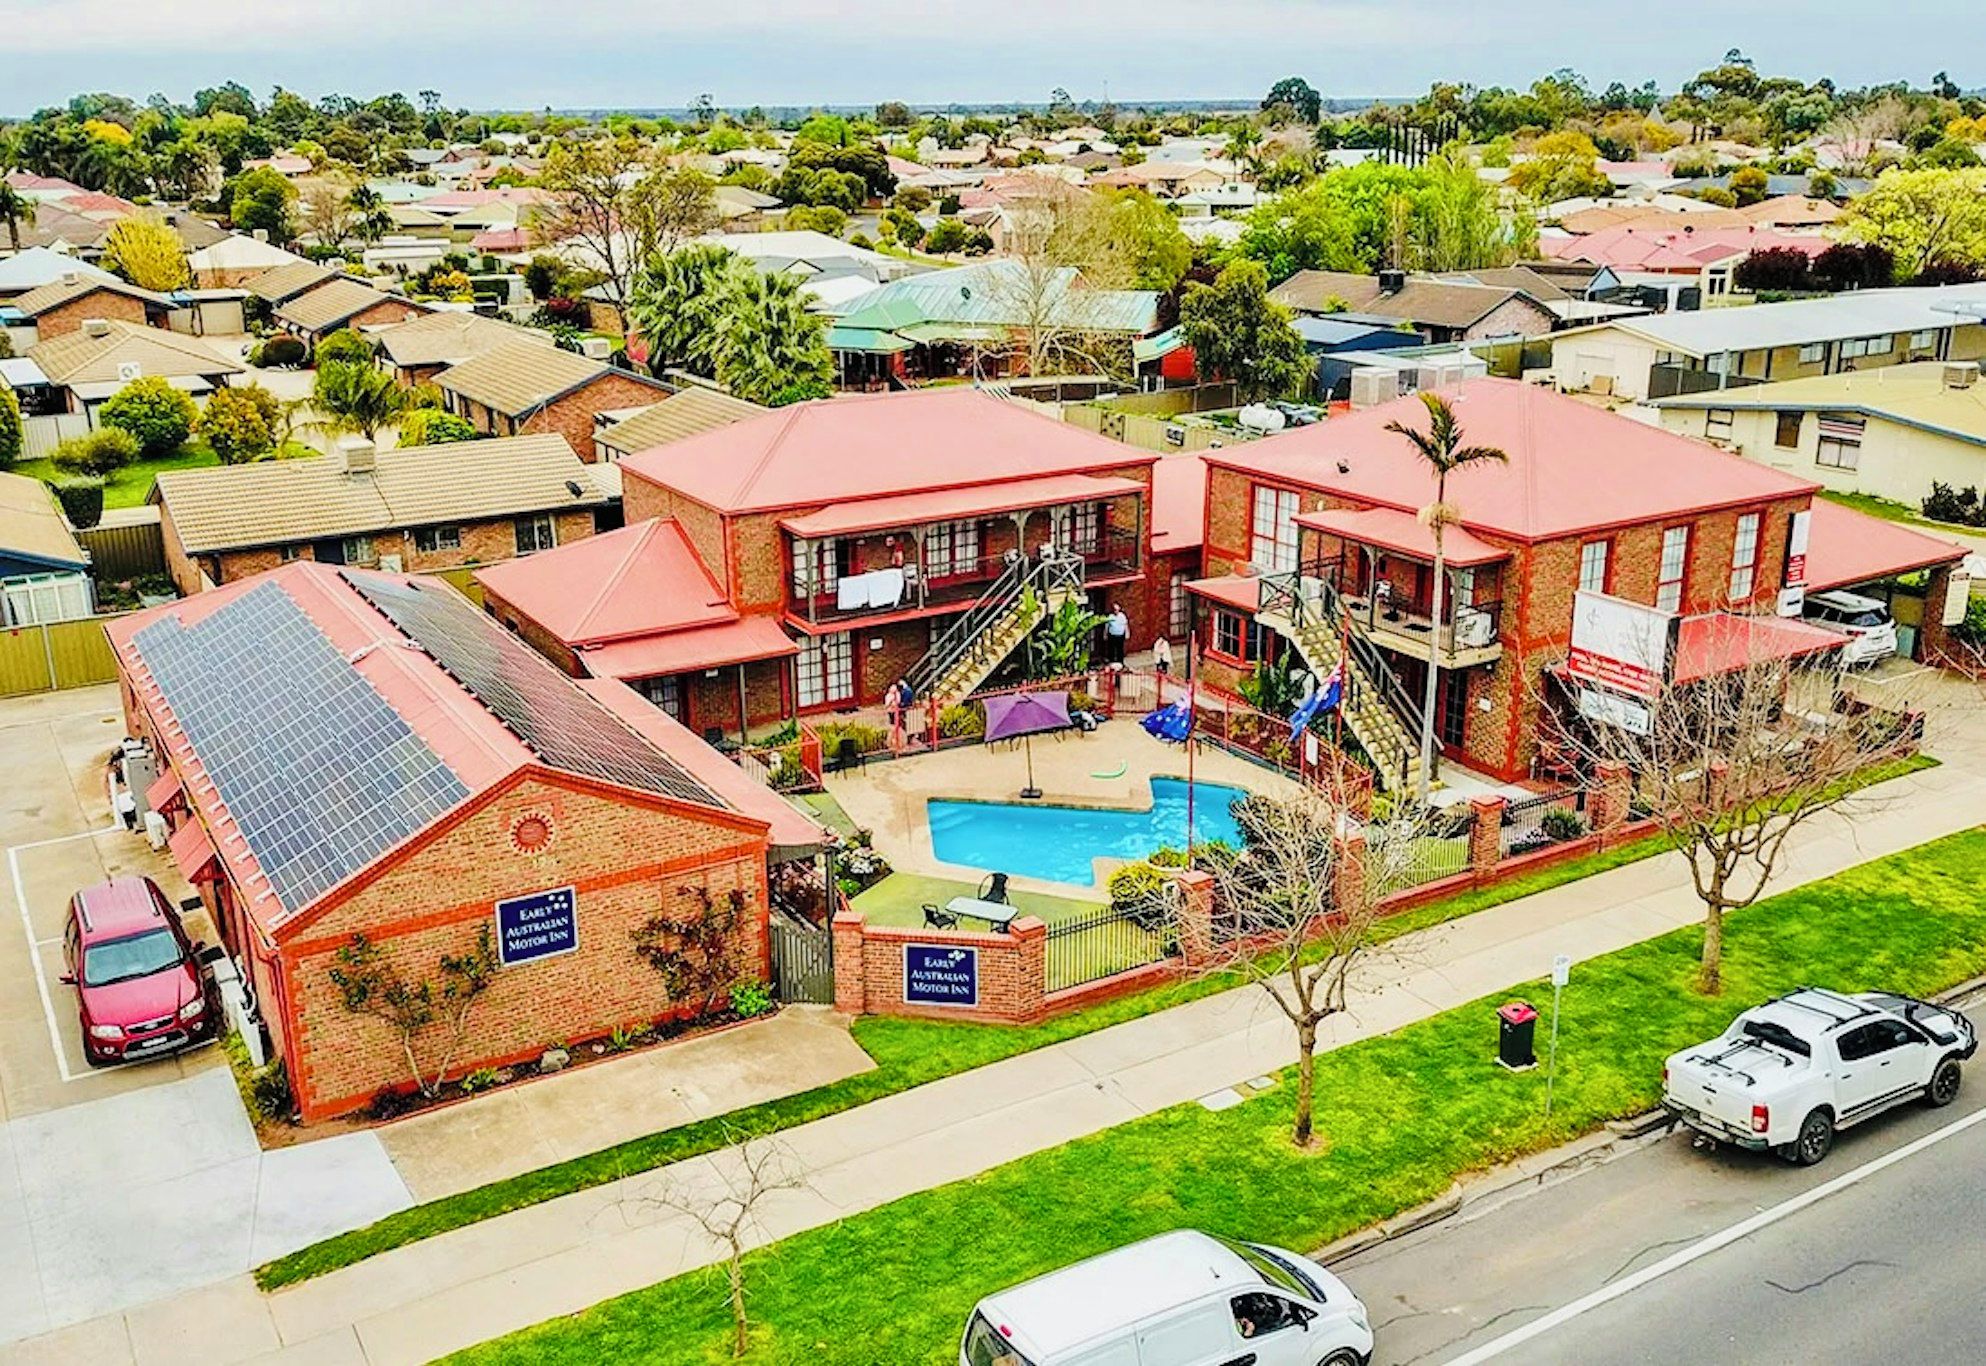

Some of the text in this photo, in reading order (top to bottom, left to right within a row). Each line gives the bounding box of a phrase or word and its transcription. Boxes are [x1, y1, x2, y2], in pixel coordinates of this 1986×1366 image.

[519, 906, 553, 921] EARLY
[506, 916, 569, 938] AUSTRALIAN
[508, 930, 569, 952] MOTOR INN
[924, 957, 956, 969] EARLY
[911, 970, 970, 982] AUSTRALIAN
[912, 982, 970, 995] MOTOR INN
